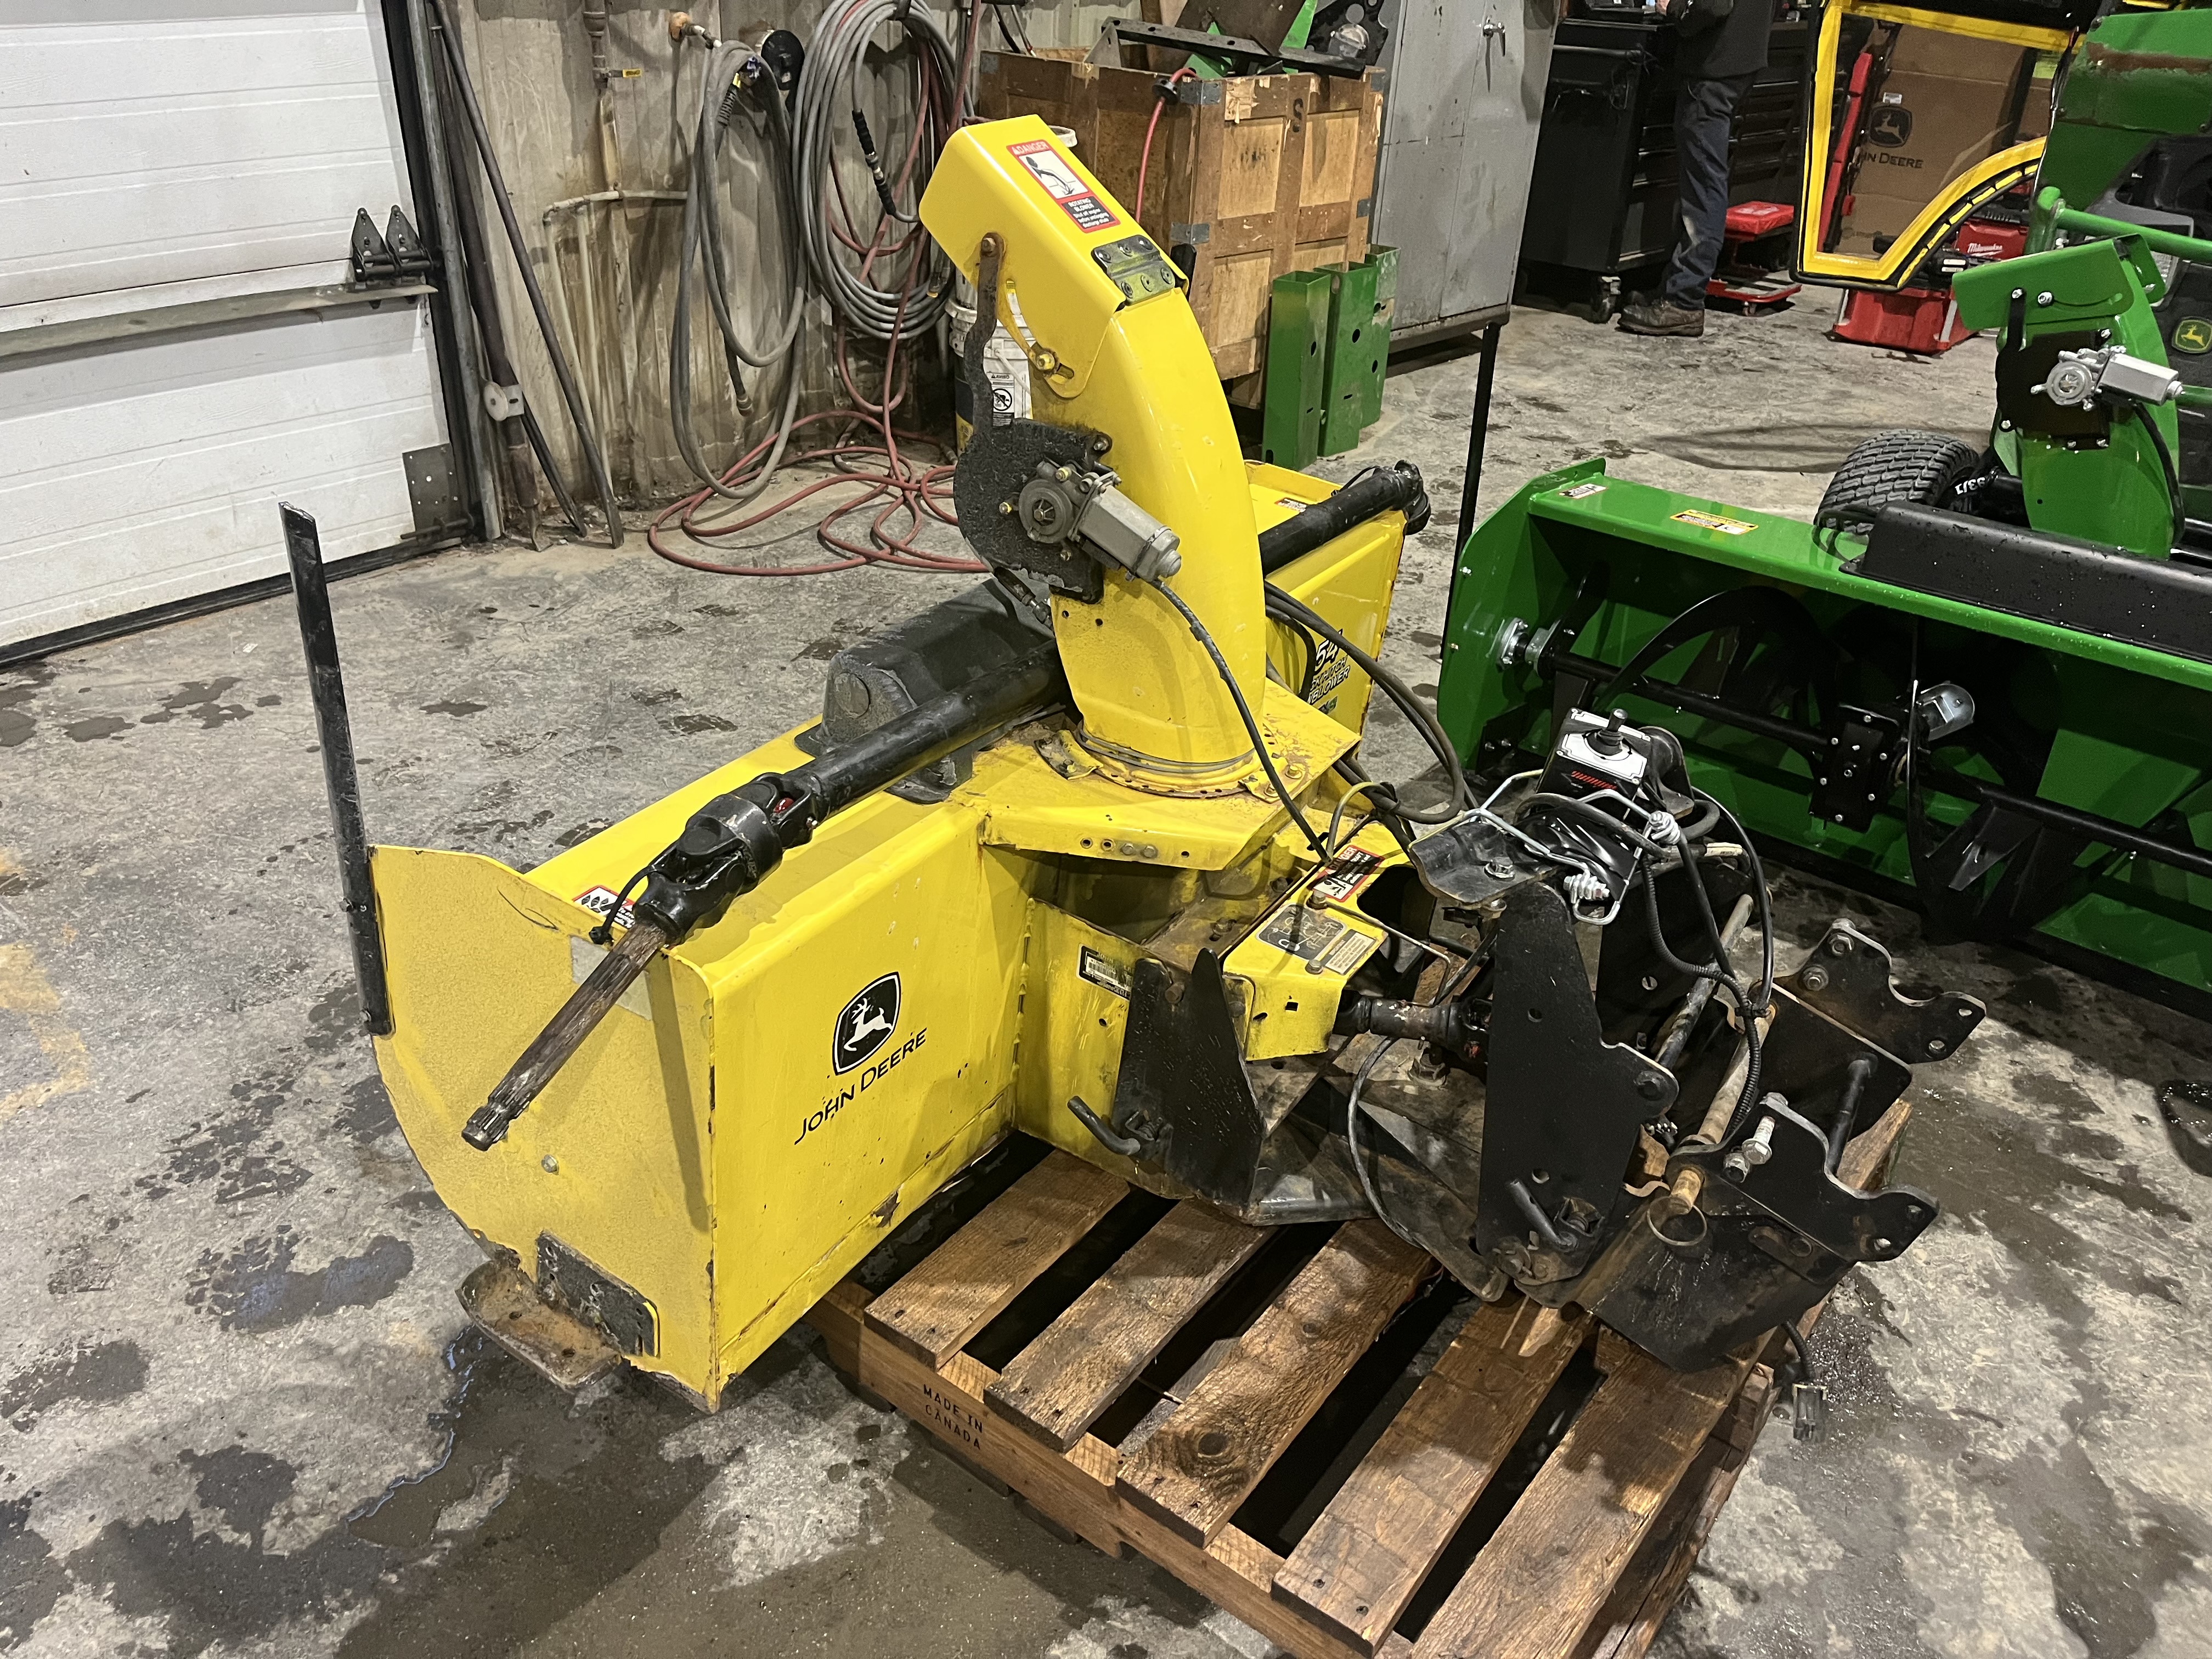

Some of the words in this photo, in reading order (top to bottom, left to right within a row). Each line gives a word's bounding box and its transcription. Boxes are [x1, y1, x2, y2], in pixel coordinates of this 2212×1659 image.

[1016, 141, 1050, 154] DANGER
[1878, 153, 1923, 168] DEERE
[1967, 243, 2002, 253] Milwaukee
[1308, 665, 1351, 705] WBLOWER
[1329, 847, 1357, 871] DANGER
[794, 1084, 855, 1145] JOHN
[861, 1028, 927, 1092] DEERE
[923, 1384, 960, 1416] MADE
[968, 1414, 983, 1433] IN
[926, 1404, 981, 1450] CANADA
